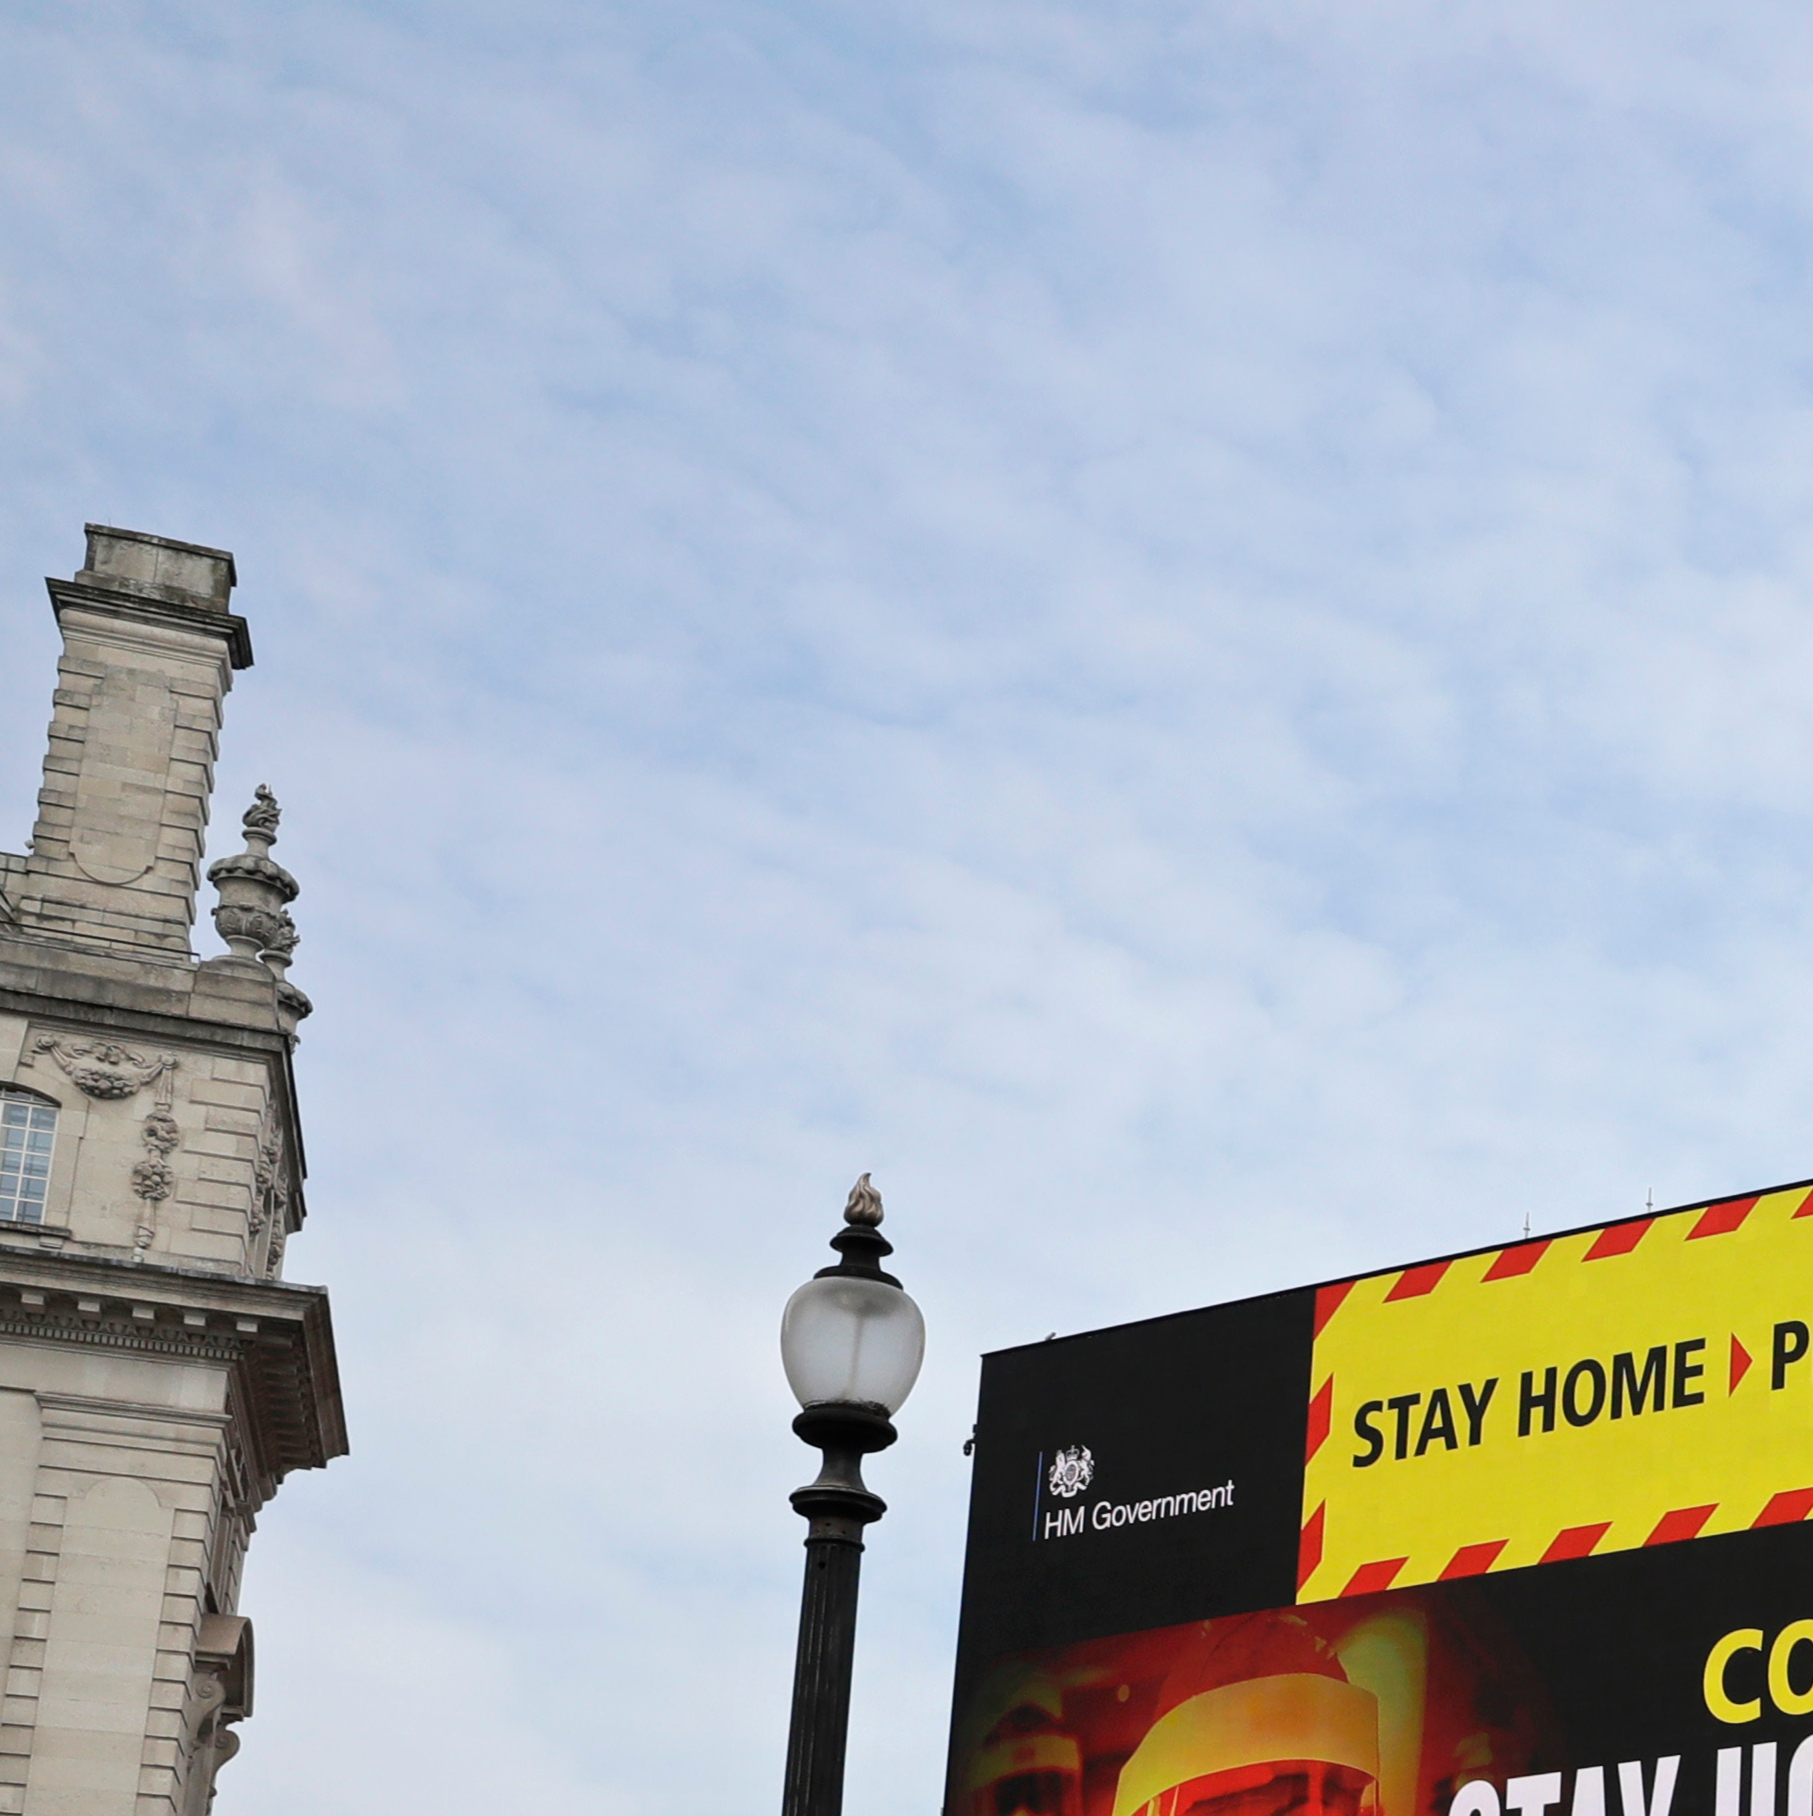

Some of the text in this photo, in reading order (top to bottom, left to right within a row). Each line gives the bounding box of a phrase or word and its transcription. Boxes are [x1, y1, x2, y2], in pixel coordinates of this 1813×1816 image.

[1351, 1377, 1499, 1469] STAY
[1517, 1337, 1706, 1438] HOME
[1044, 1479, 1235, 1540] HM Government
